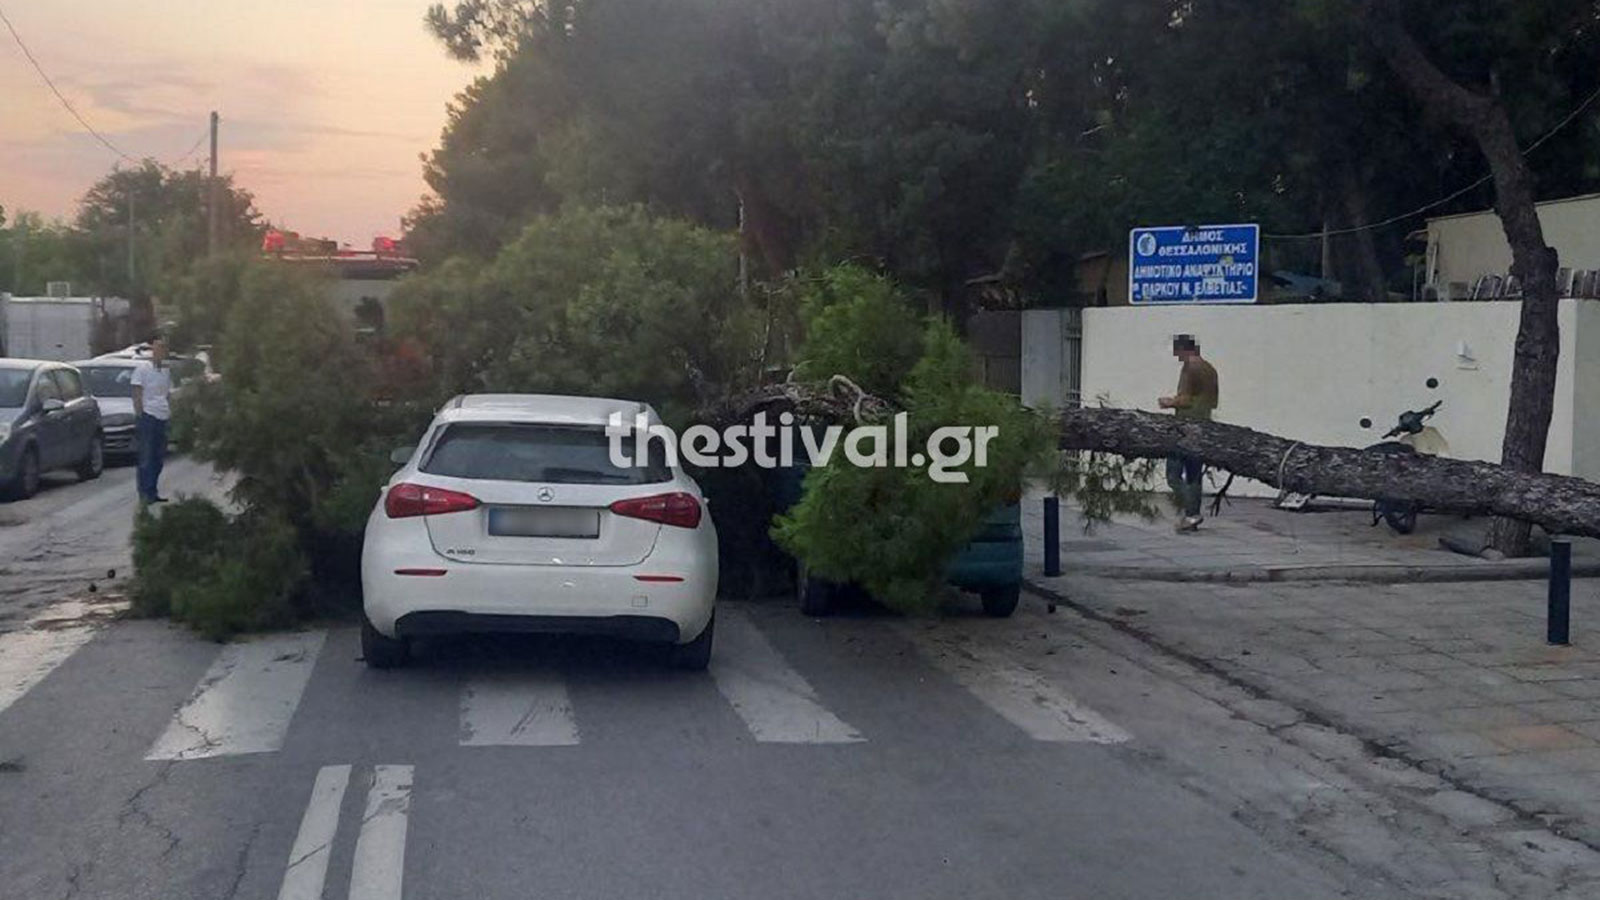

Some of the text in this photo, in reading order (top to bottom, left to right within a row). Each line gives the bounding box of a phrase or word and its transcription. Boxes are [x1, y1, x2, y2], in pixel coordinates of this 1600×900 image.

[1182, 230, 1224, 242] ΔΗΜΟΣ
[1158, 243, 1247, 256] ΘΕΣΣΑΛΟΝΙΚΗΣ
[1134, 264, 1181, 278] ΔΗΜΟΤΙΚΟ
[1142, 282, 1180, 296] ΠΑΡΚΟΥ
